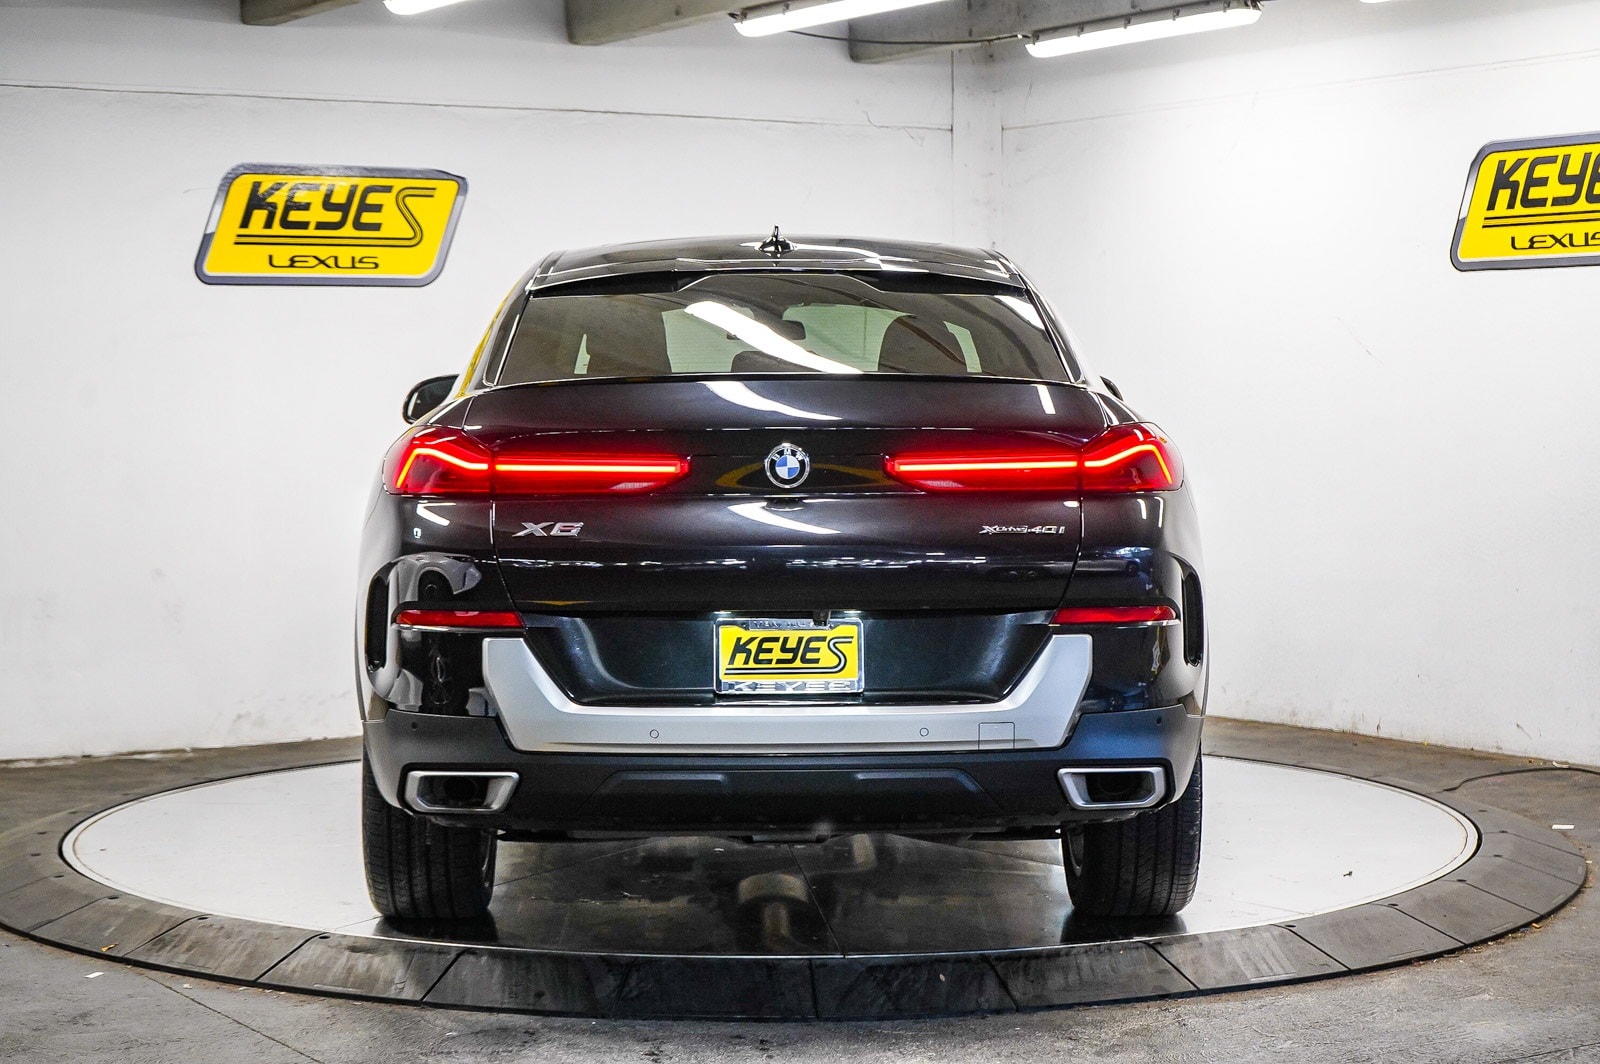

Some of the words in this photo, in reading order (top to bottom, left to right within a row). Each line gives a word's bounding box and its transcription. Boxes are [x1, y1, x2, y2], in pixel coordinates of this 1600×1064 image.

[236, 181, 436, 247] KEYES
[268, 254, 379, 269] LEXUS
[512, 522, 584, 537] X6
[726, 636, 854, 675] KEYES
